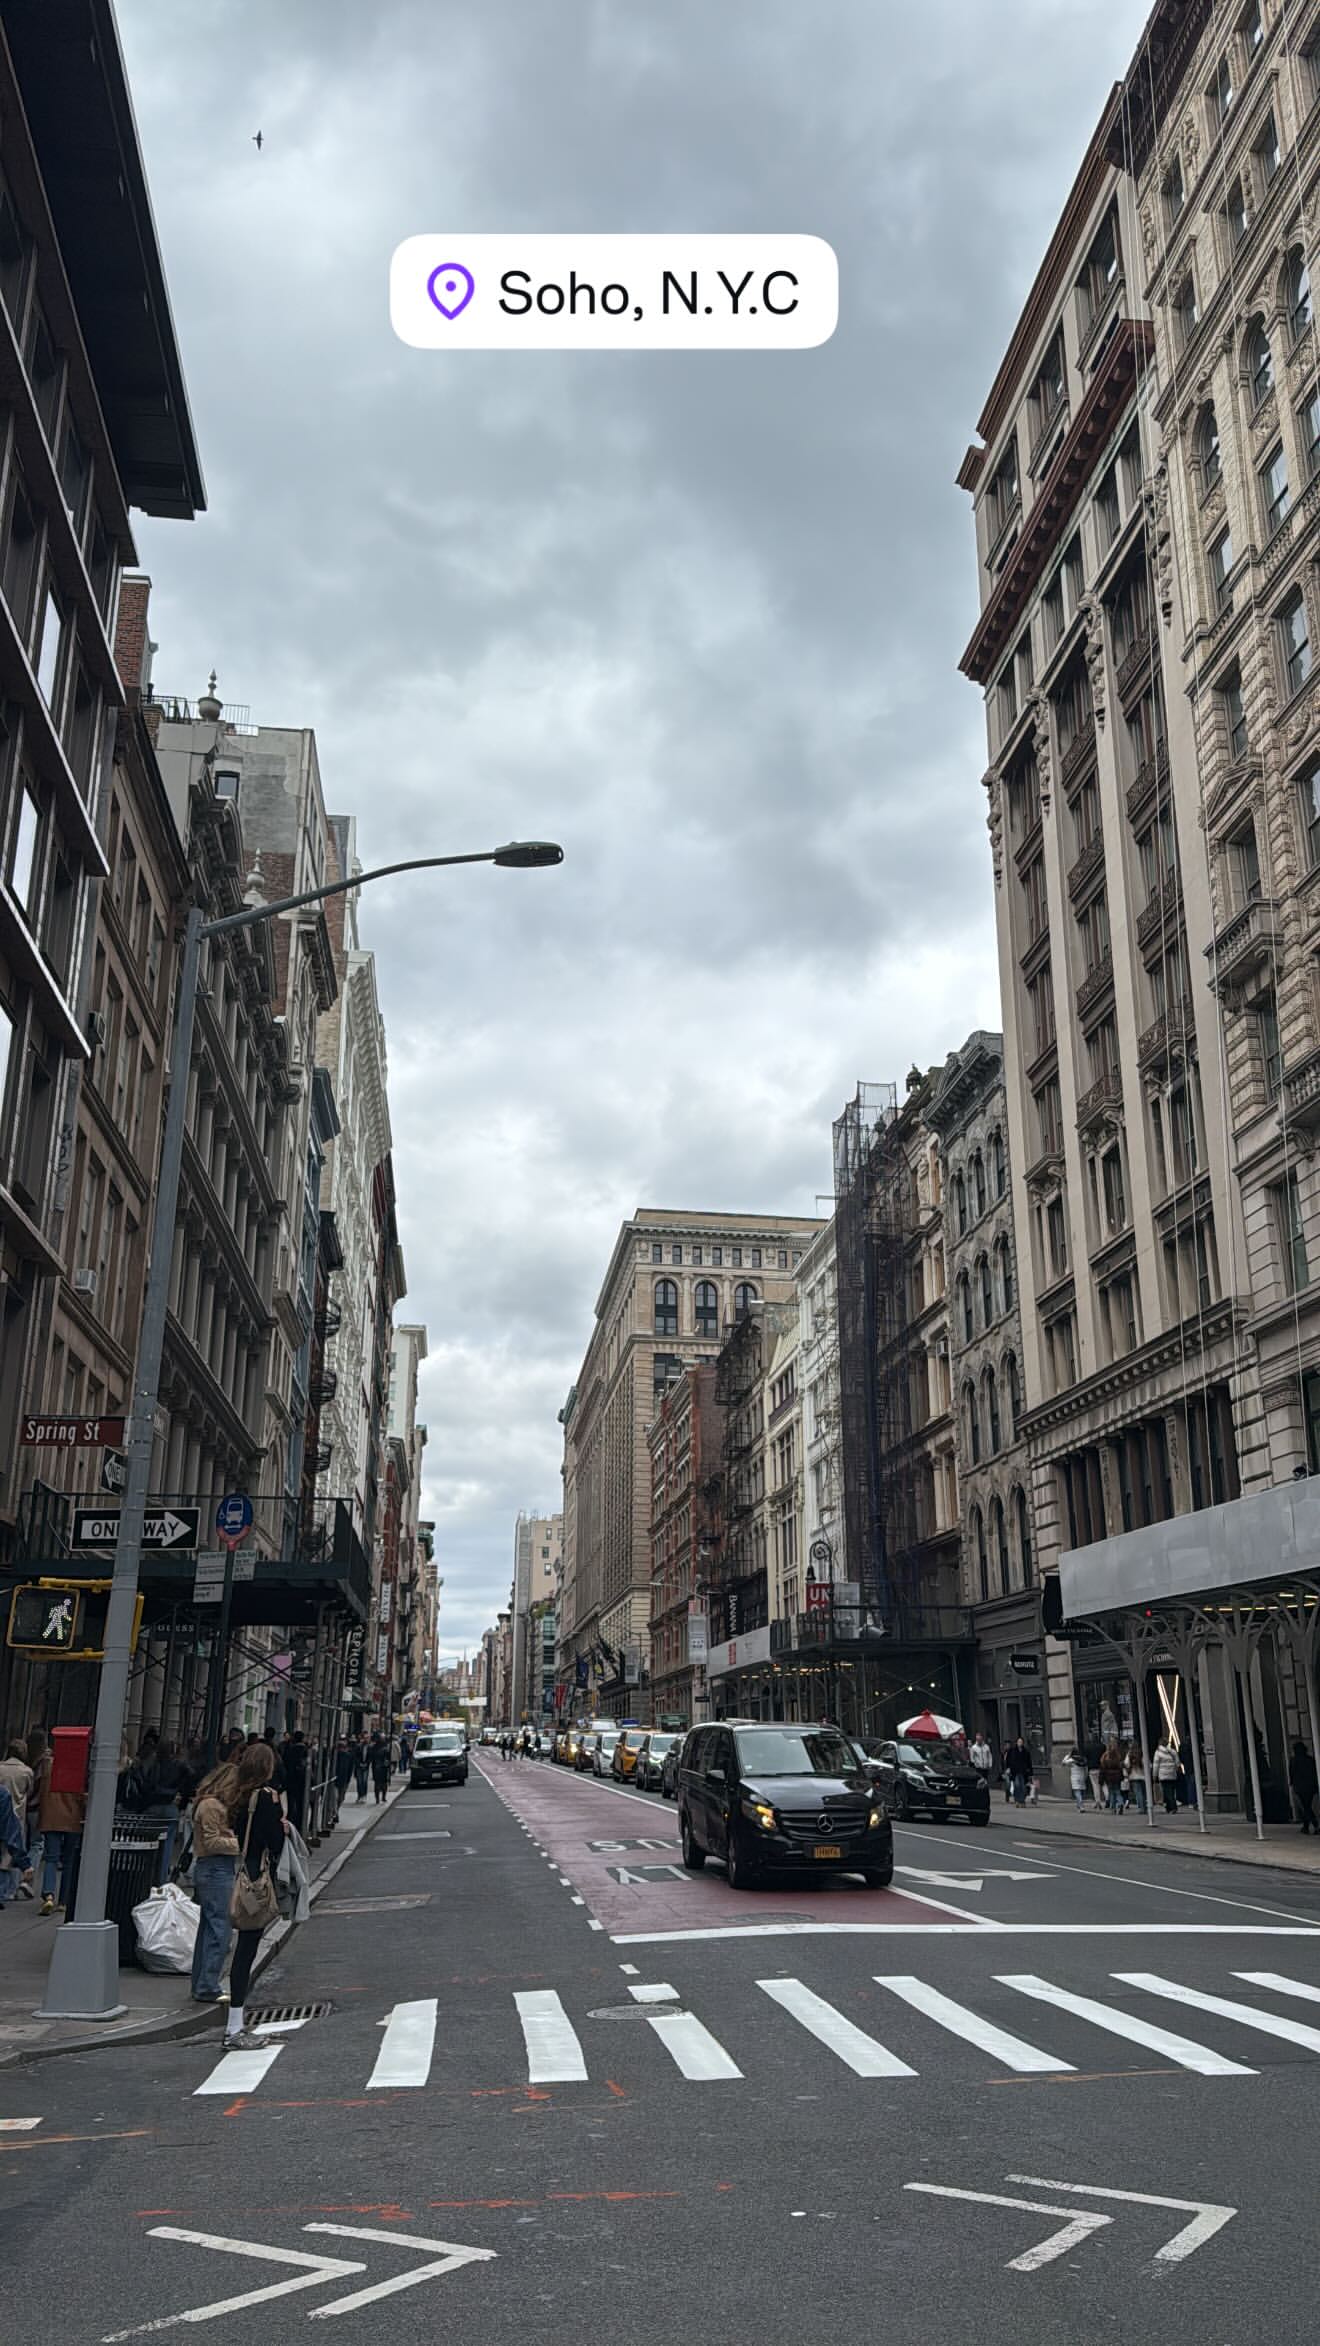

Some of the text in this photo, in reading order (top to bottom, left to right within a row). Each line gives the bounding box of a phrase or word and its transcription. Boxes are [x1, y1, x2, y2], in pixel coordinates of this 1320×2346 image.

[26, 1420, 99, 1445] Spring St
[91, 1522, 179, 1537] ON WAY
[592, 1839, 683, 1852] US
[615, 1865, 692, 1884] LY
